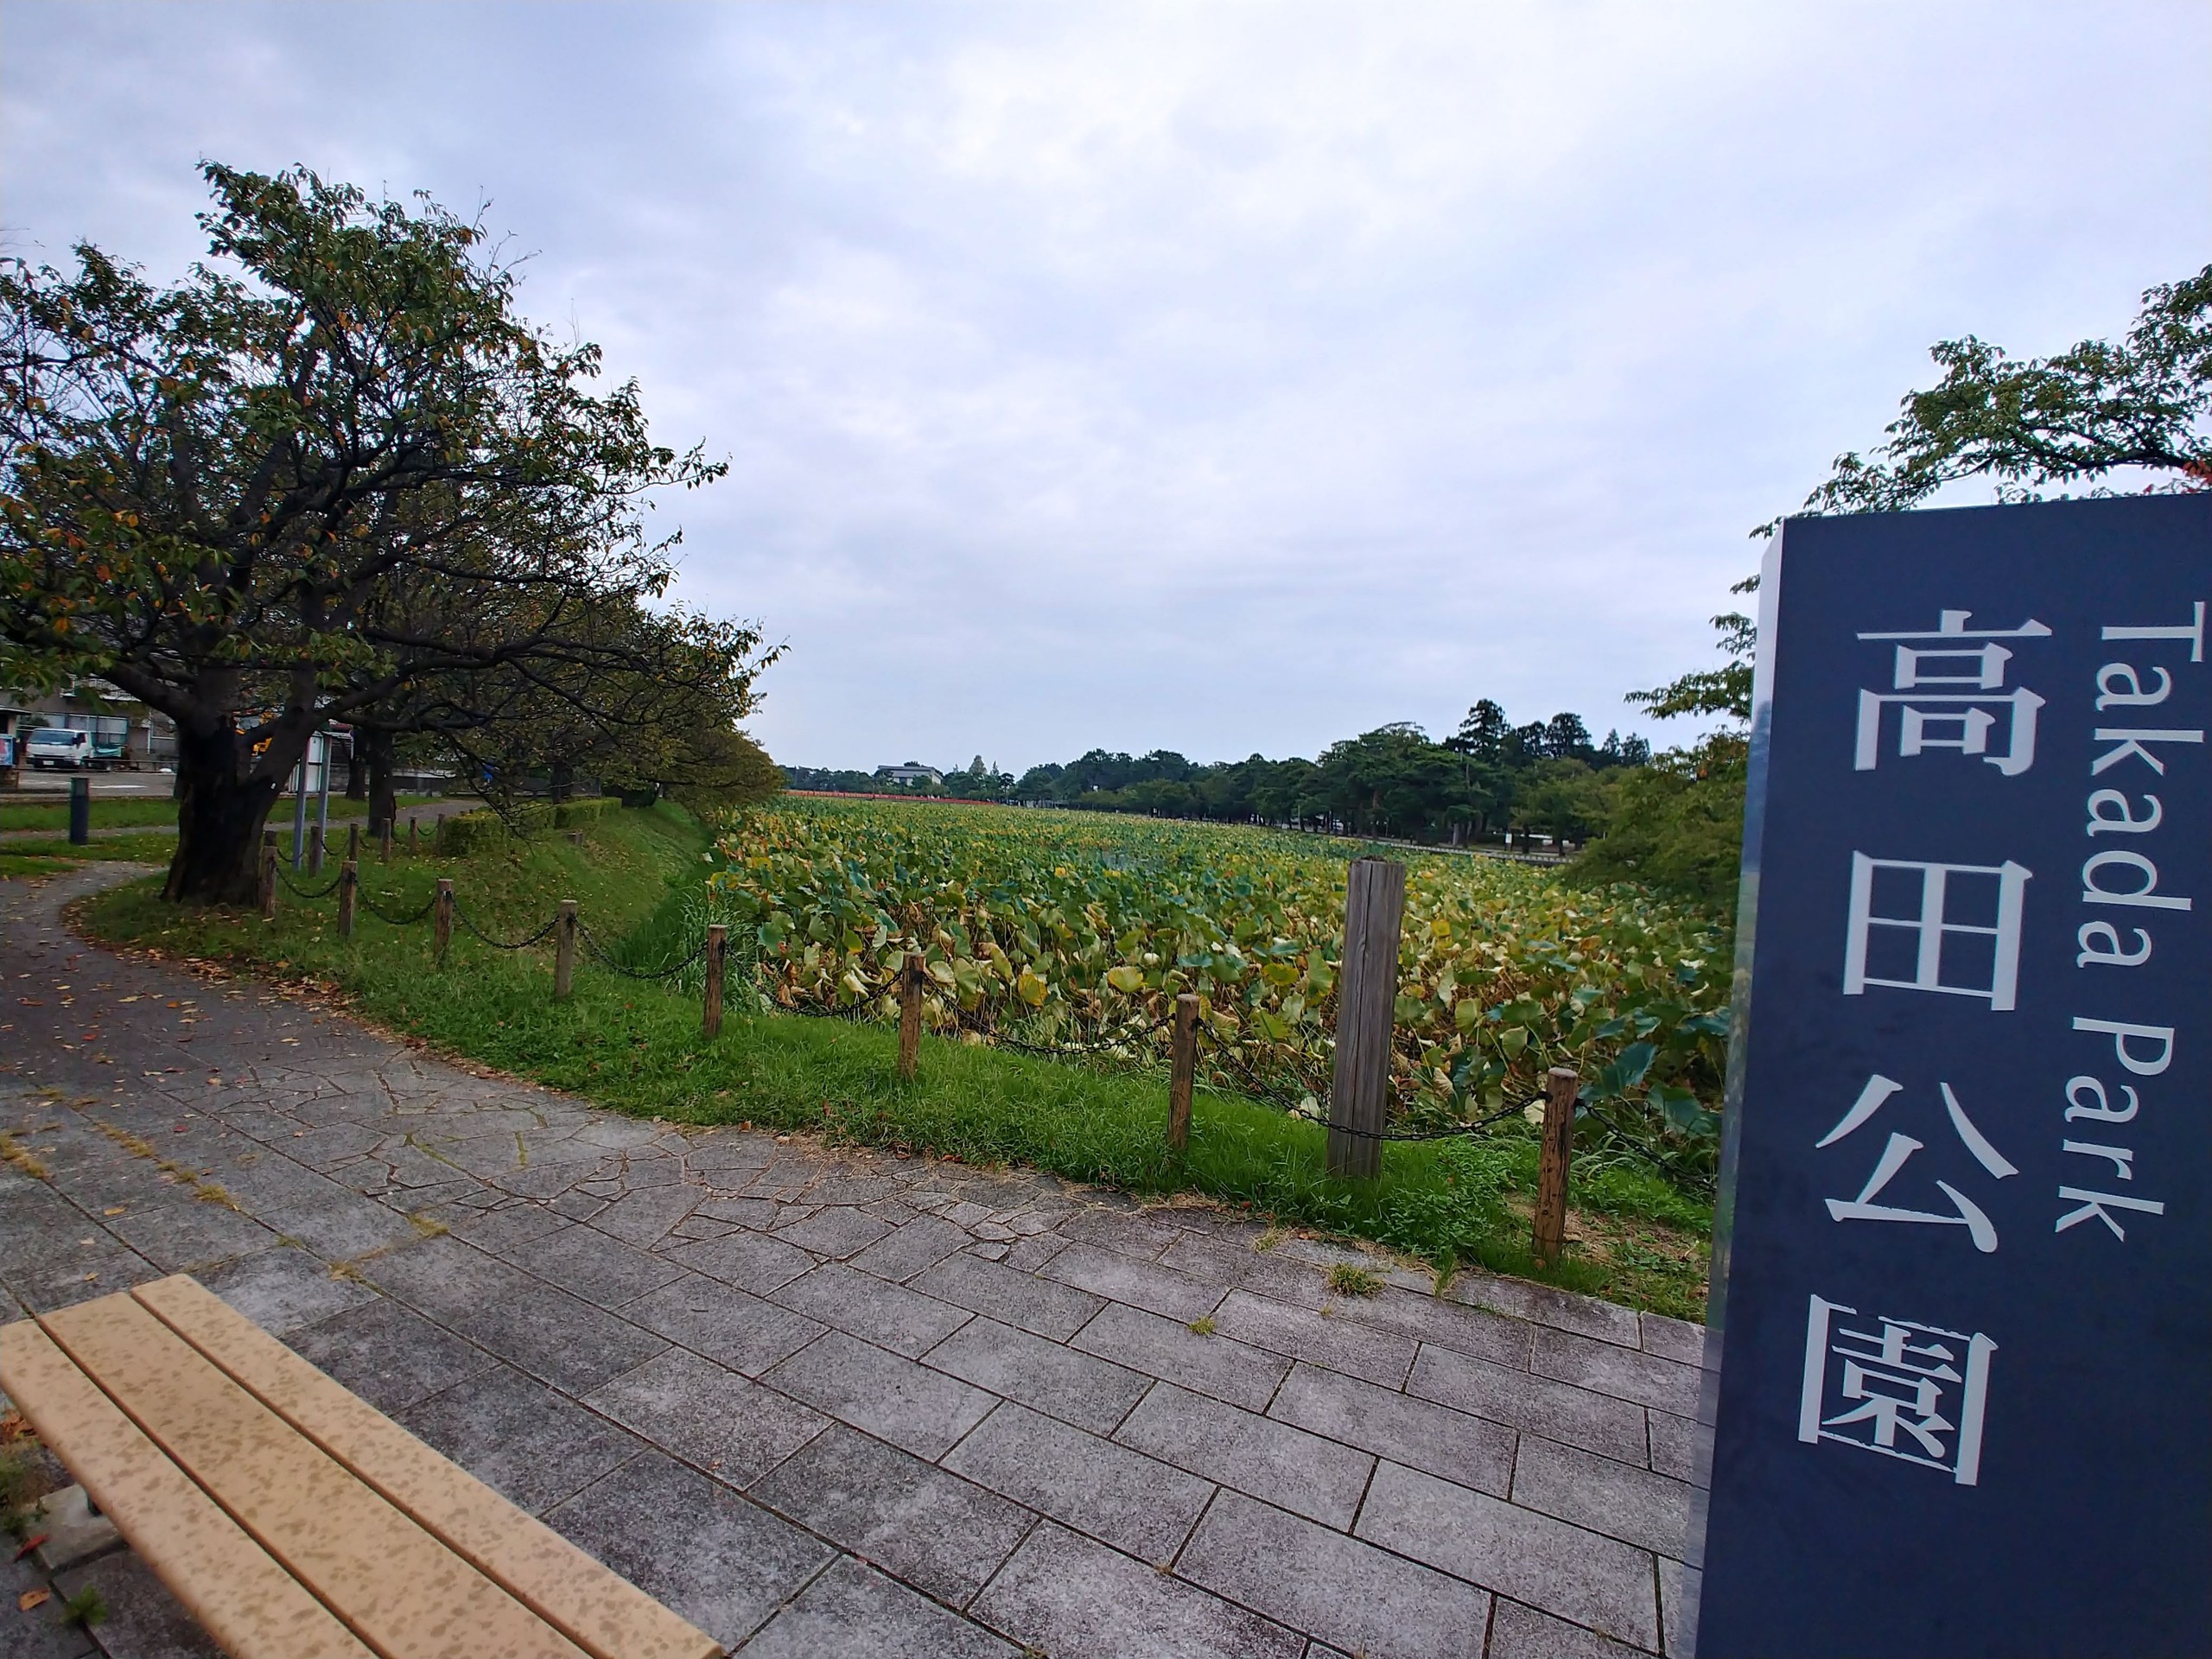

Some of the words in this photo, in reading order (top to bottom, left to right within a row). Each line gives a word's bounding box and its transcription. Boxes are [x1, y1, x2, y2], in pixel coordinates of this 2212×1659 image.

[2076, 601, 2205, 968] Takada
[1798, 609, 2053, 1485] 高田公園
[2055, 1017, 2175, 1242] Park
